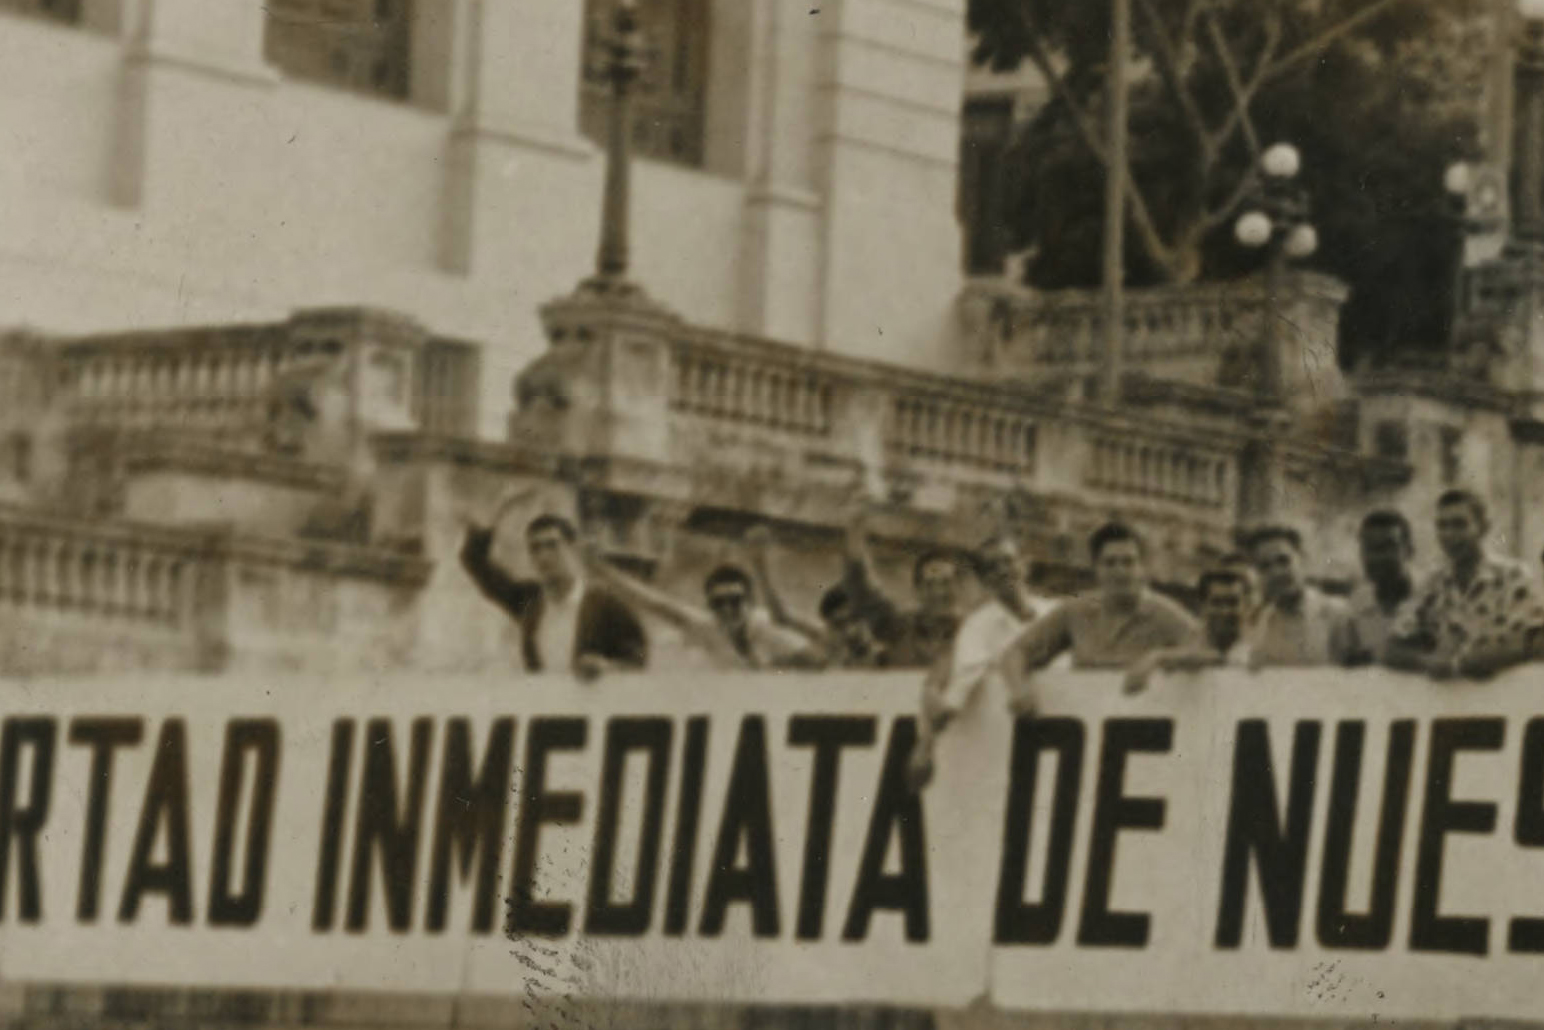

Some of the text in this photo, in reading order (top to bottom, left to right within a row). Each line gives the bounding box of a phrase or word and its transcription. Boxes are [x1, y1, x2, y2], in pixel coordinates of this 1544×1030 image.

[0, 716, 282, 928] RTAD
[312, 714, 934, 944] INMEDIATA
[992, 713, 1176, 949] DE
